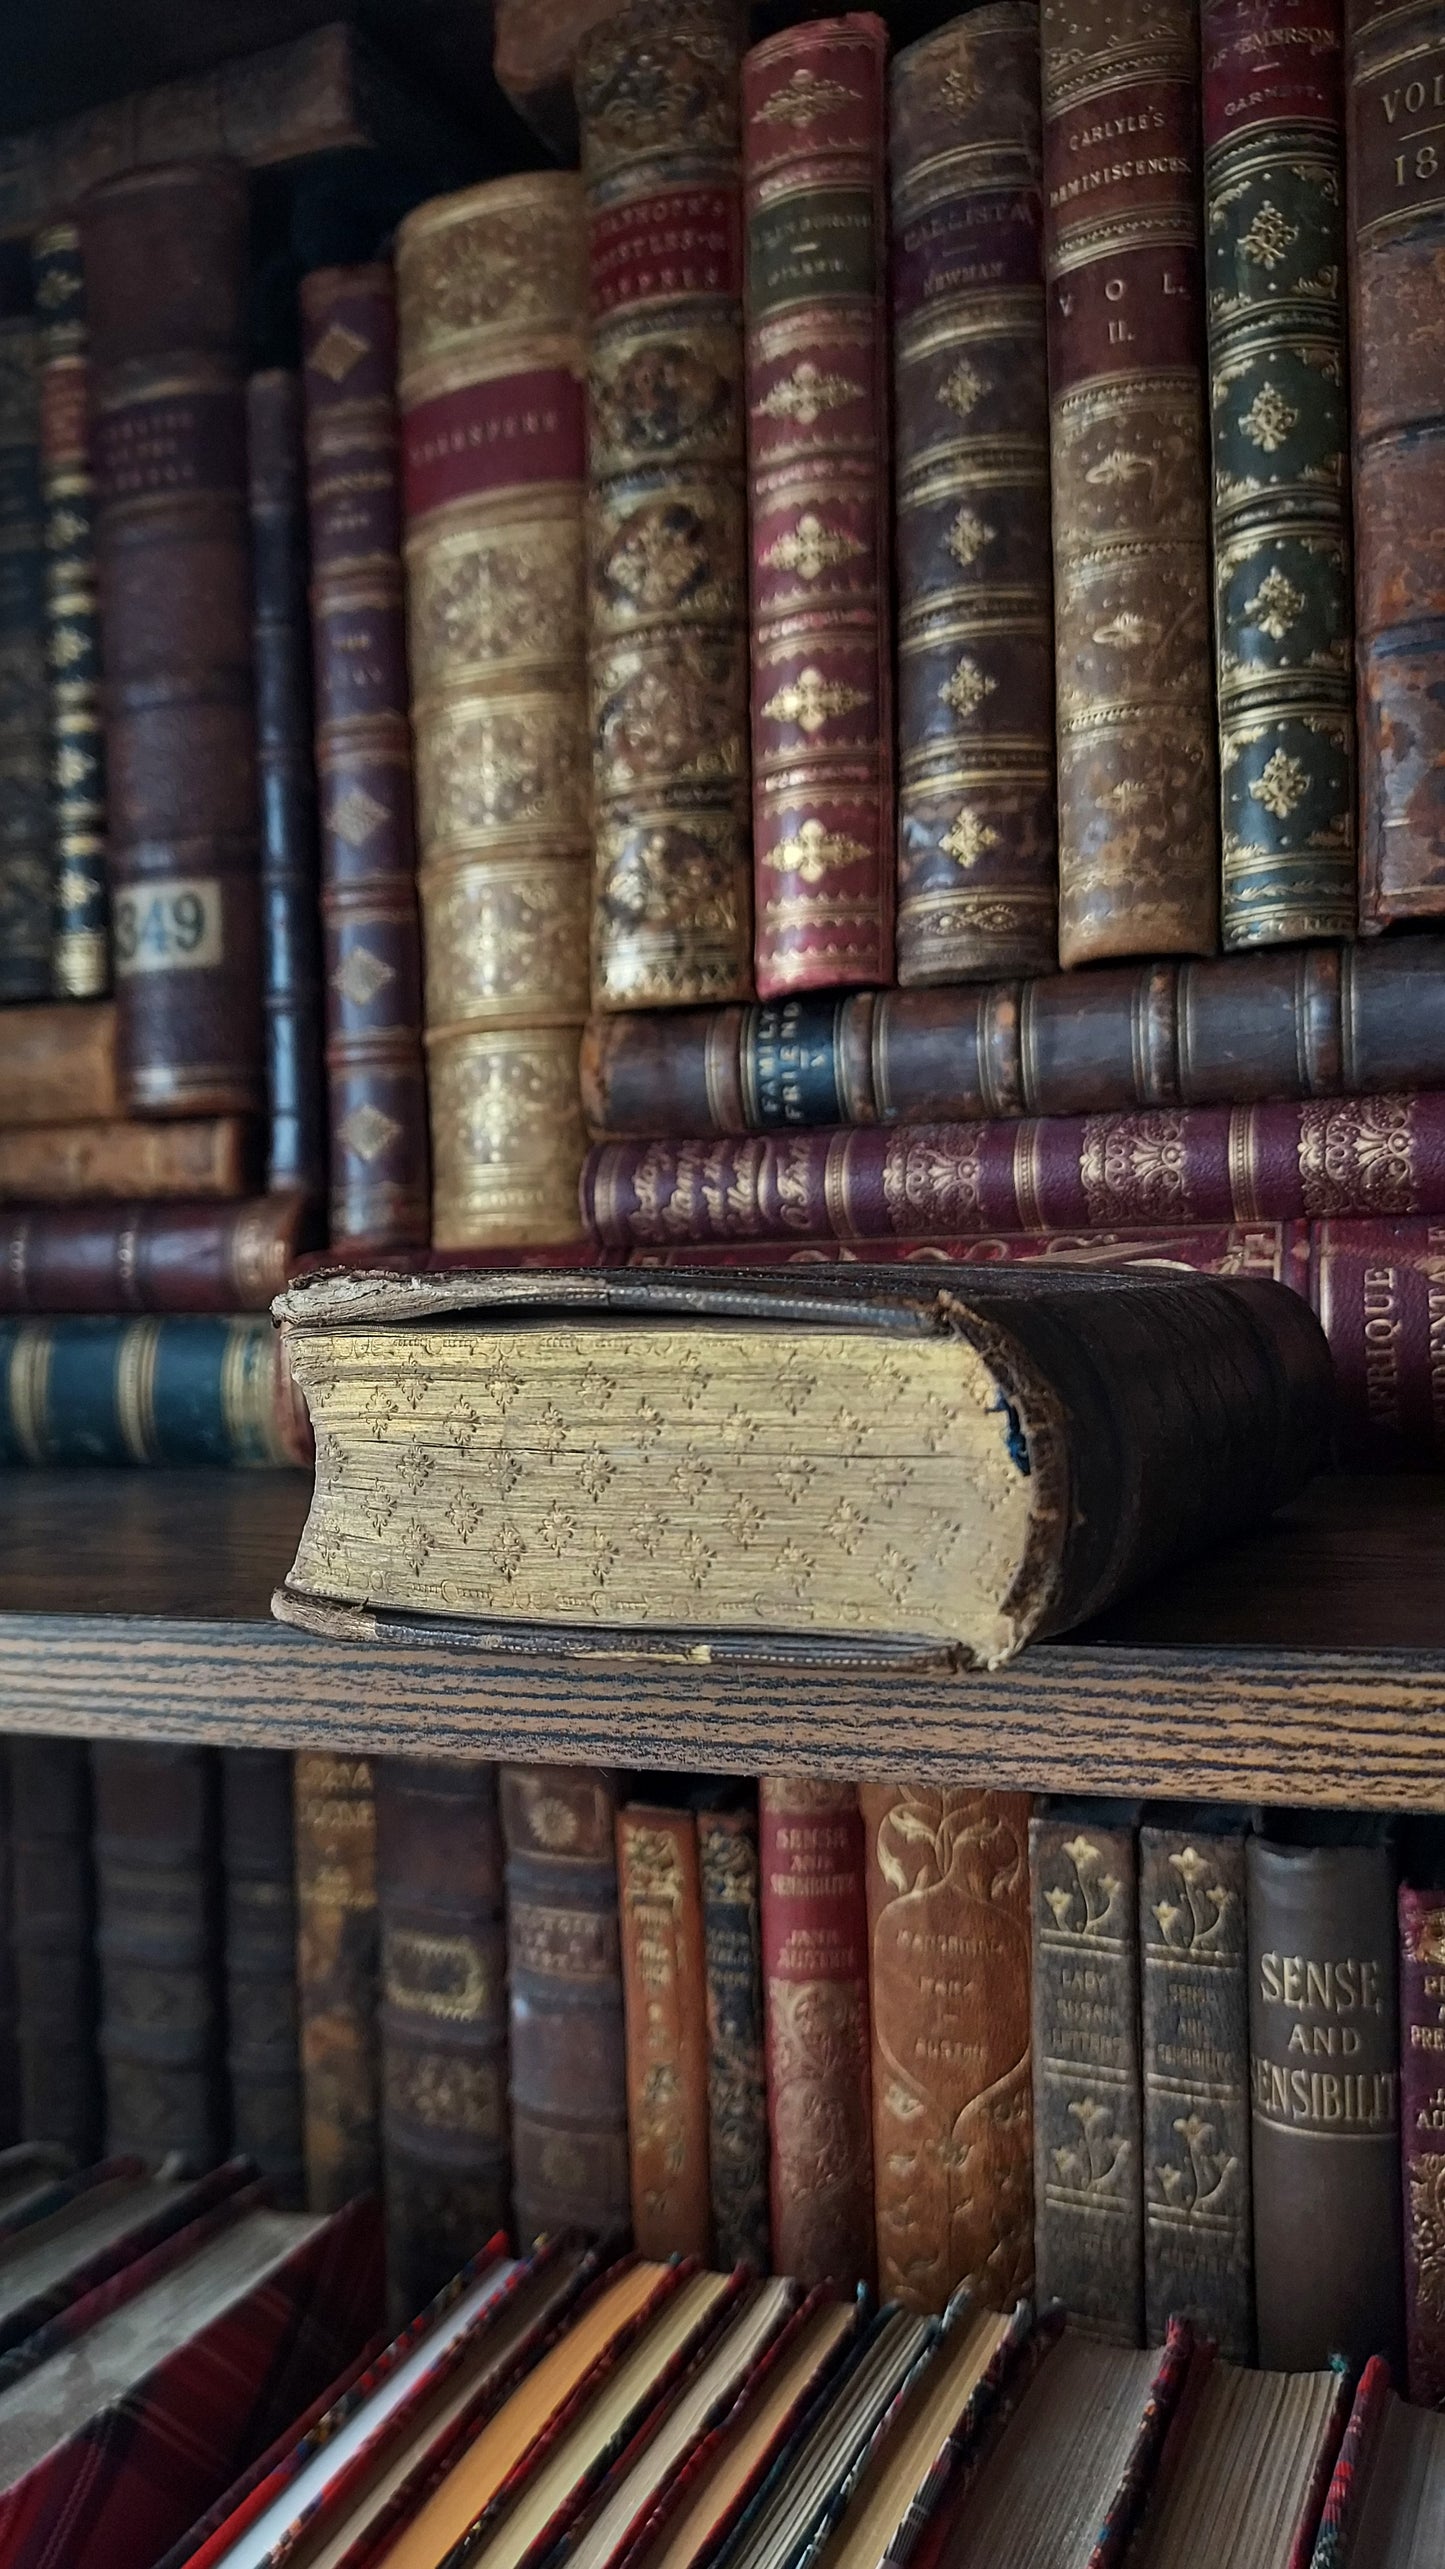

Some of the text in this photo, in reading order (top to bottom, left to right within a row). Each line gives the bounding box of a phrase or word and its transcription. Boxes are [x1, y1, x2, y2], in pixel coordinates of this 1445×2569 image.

[1069, 105, 1166, 151] CARLYLE'S
[757, 1008, 779, 1113] FAMILY
[779, 1001, 803, 1119] FRIEND
[1260, 1951, 1381, 2016] SENSE
[1287, 2024, 1361, 2055] AND
[1251, 2055, 1396, 2124] ENSIBILIT
